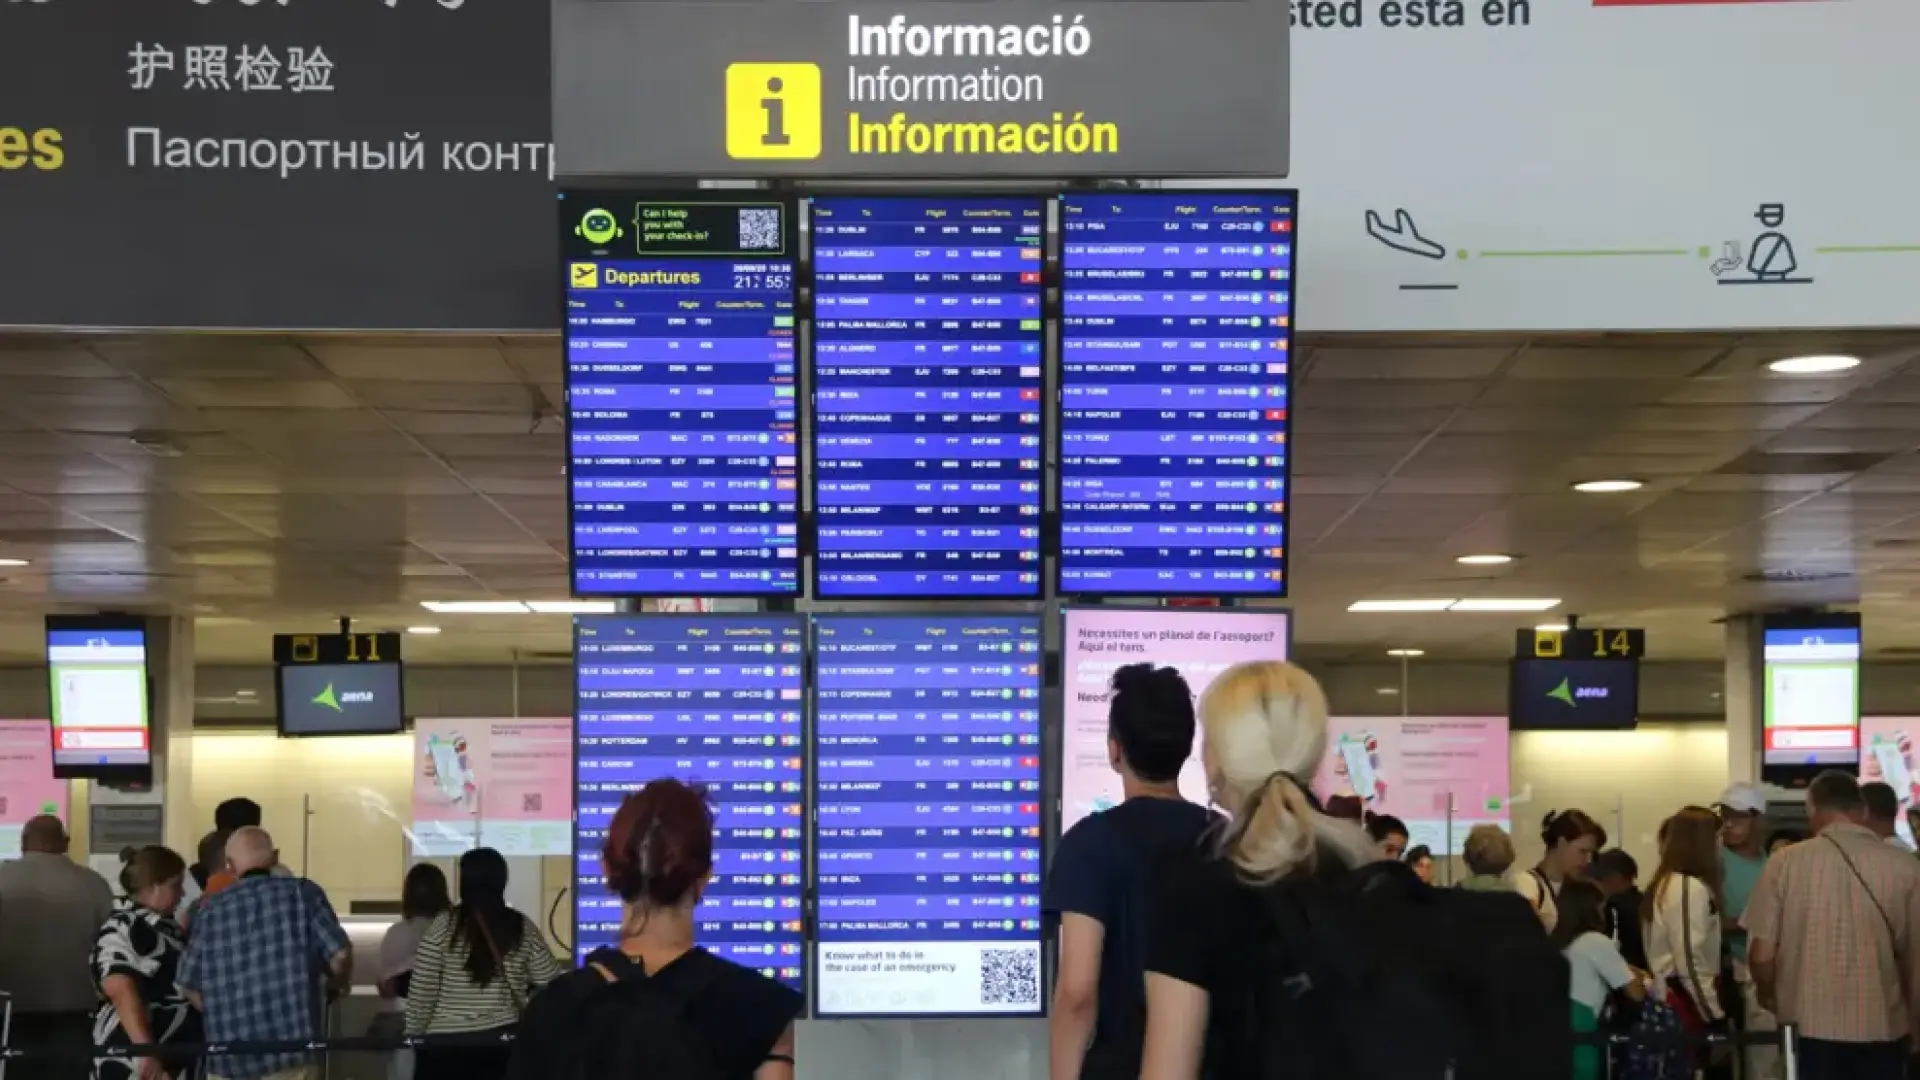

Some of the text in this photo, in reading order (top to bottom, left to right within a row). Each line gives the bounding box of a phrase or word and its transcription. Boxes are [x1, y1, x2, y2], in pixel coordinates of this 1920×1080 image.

[1482, 0, 1530, 26] en
[847, 14, 1092, 57] Informació
[127, 42, 336, 92] 护照检验
[847, 66, 1044, 103] Information
[847, 111, 1120, 154] Información
[126, 126, 426, 179] Паспортный
[605, 267, 702, 287] Departures
[347, 632, 381, 661] 11
[1077, 627, 1139, 640] Necessites
[1196, 631, 1211, 641] de
[1593, 628, 1631, 657] 14
[899, 963, 957, 974] emergency
